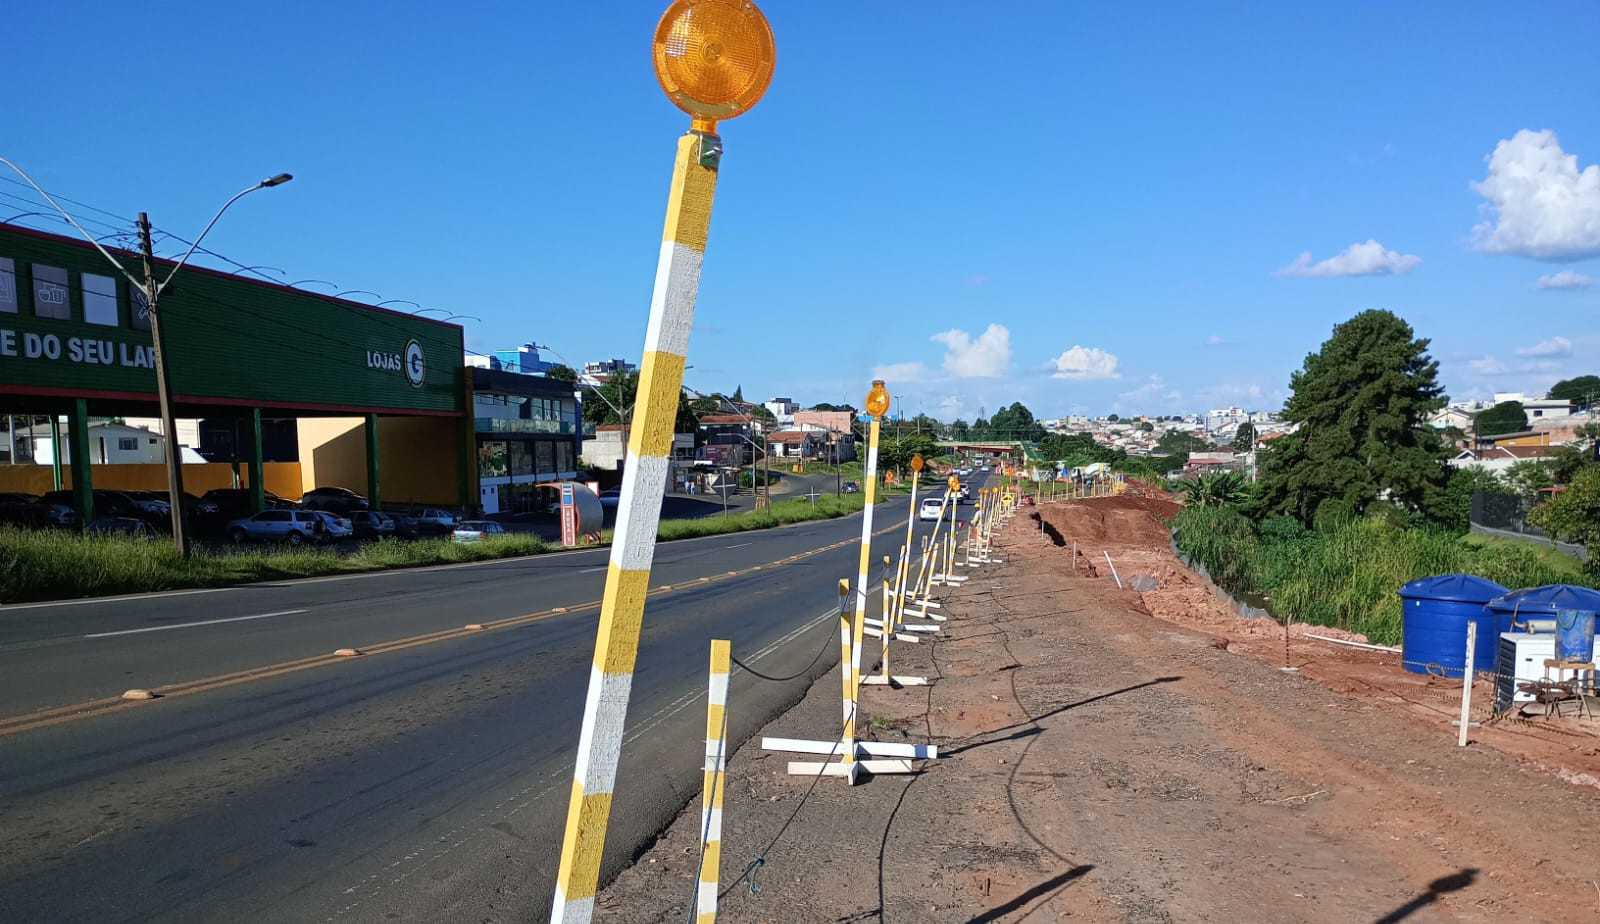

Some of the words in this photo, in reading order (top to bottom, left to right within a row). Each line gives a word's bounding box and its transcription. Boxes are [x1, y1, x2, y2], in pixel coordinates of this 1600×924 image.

[24, 333, 61, 360] DO
[68, 337, 114, 365] SEU
[367, 350, 401, 371] LOJAS
[406, 342, 424, 385] G
